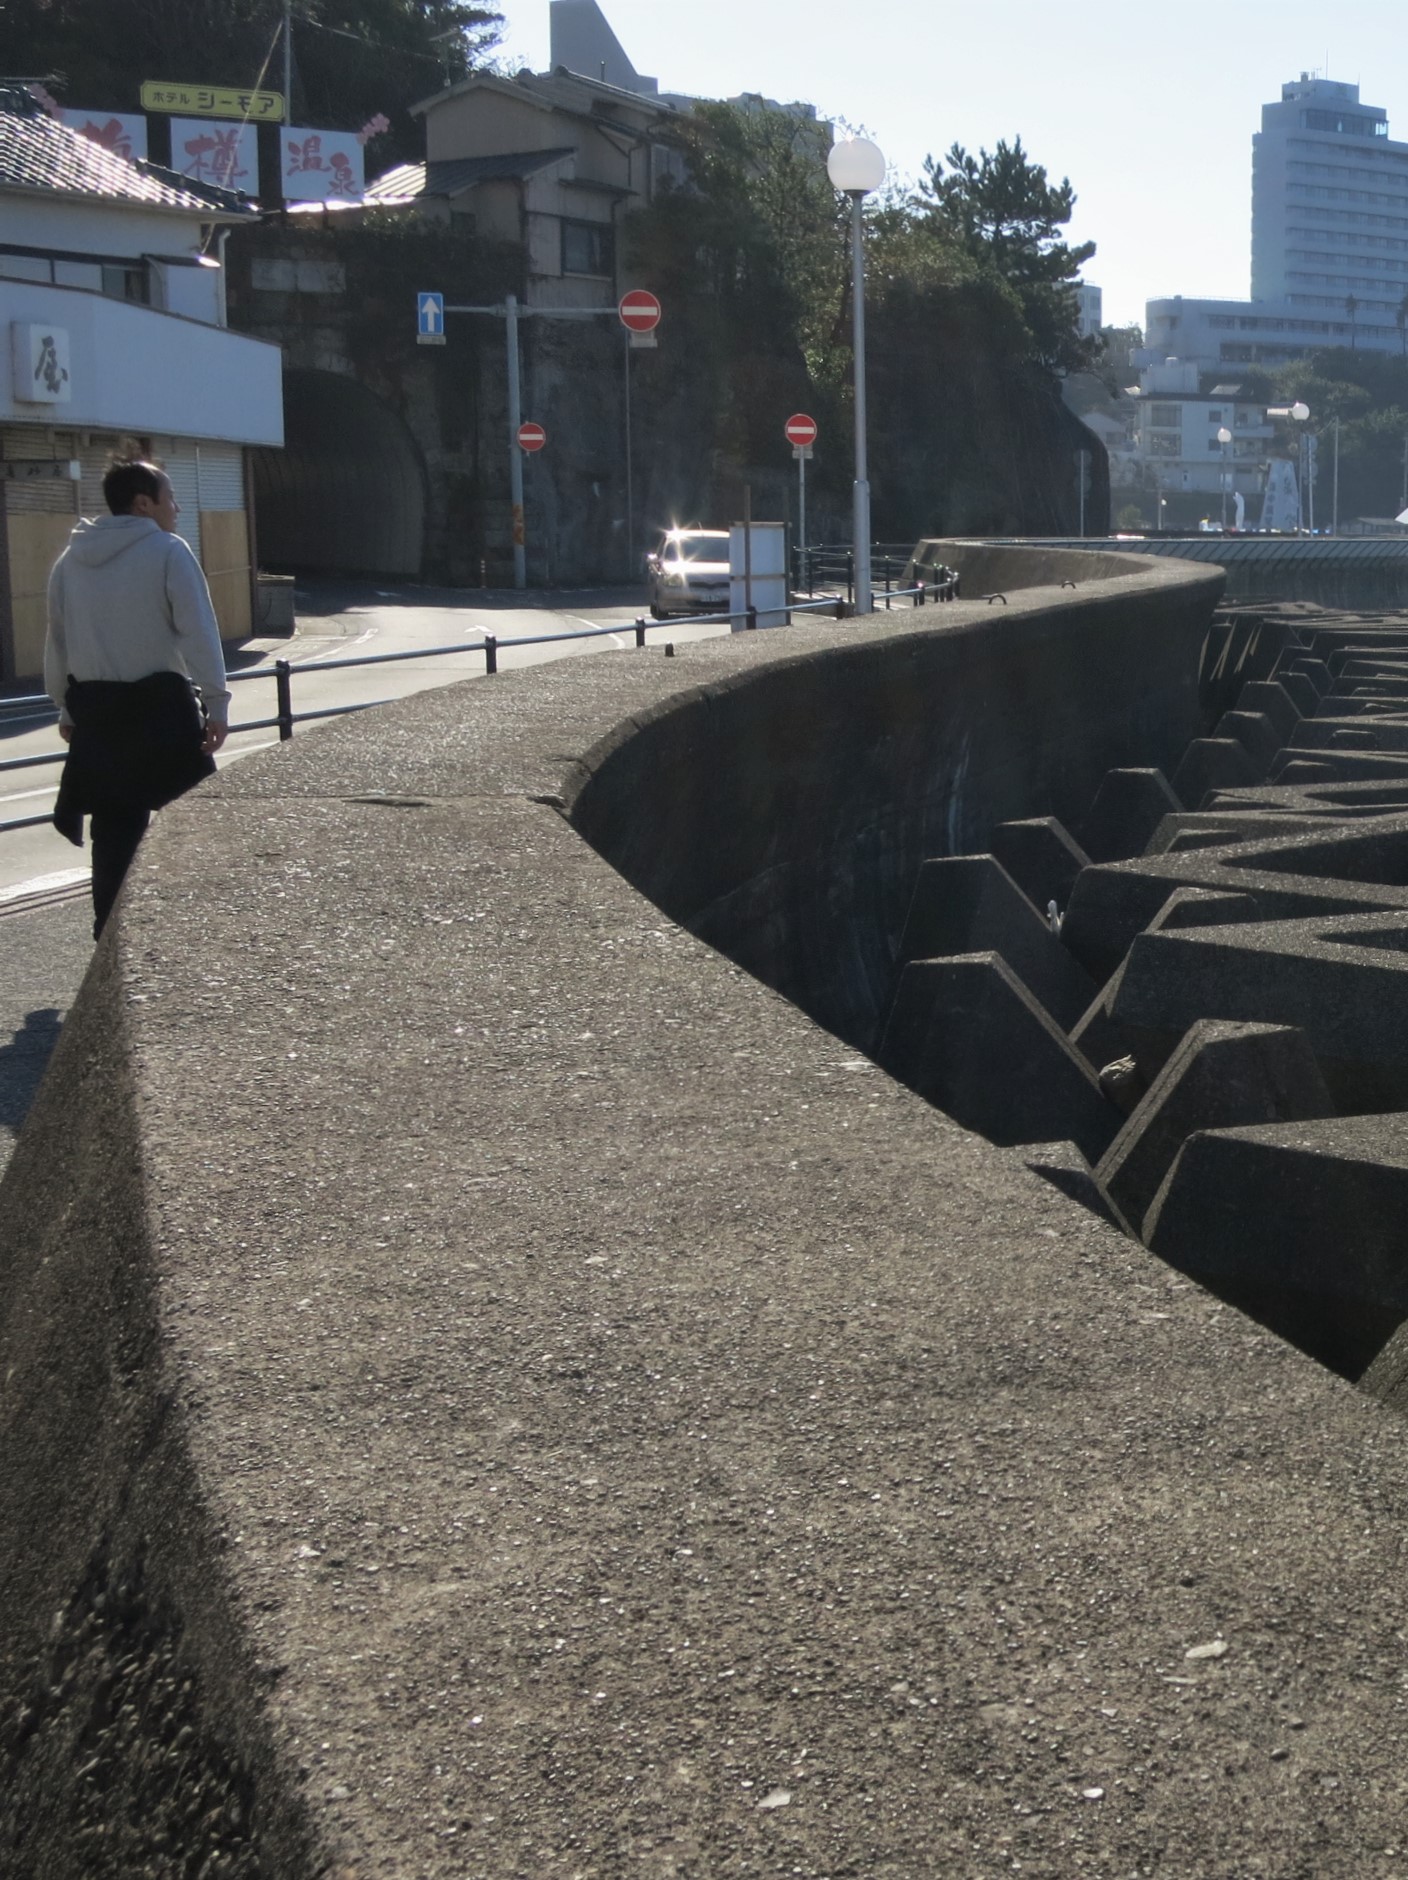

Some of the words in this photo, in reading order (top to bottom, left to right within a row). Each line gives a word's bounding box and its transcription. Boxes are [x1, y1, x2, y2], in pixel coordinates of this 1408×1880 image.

[152, 91, 190, 105] ホテル
[197, 91, 275, 114] シーモア
